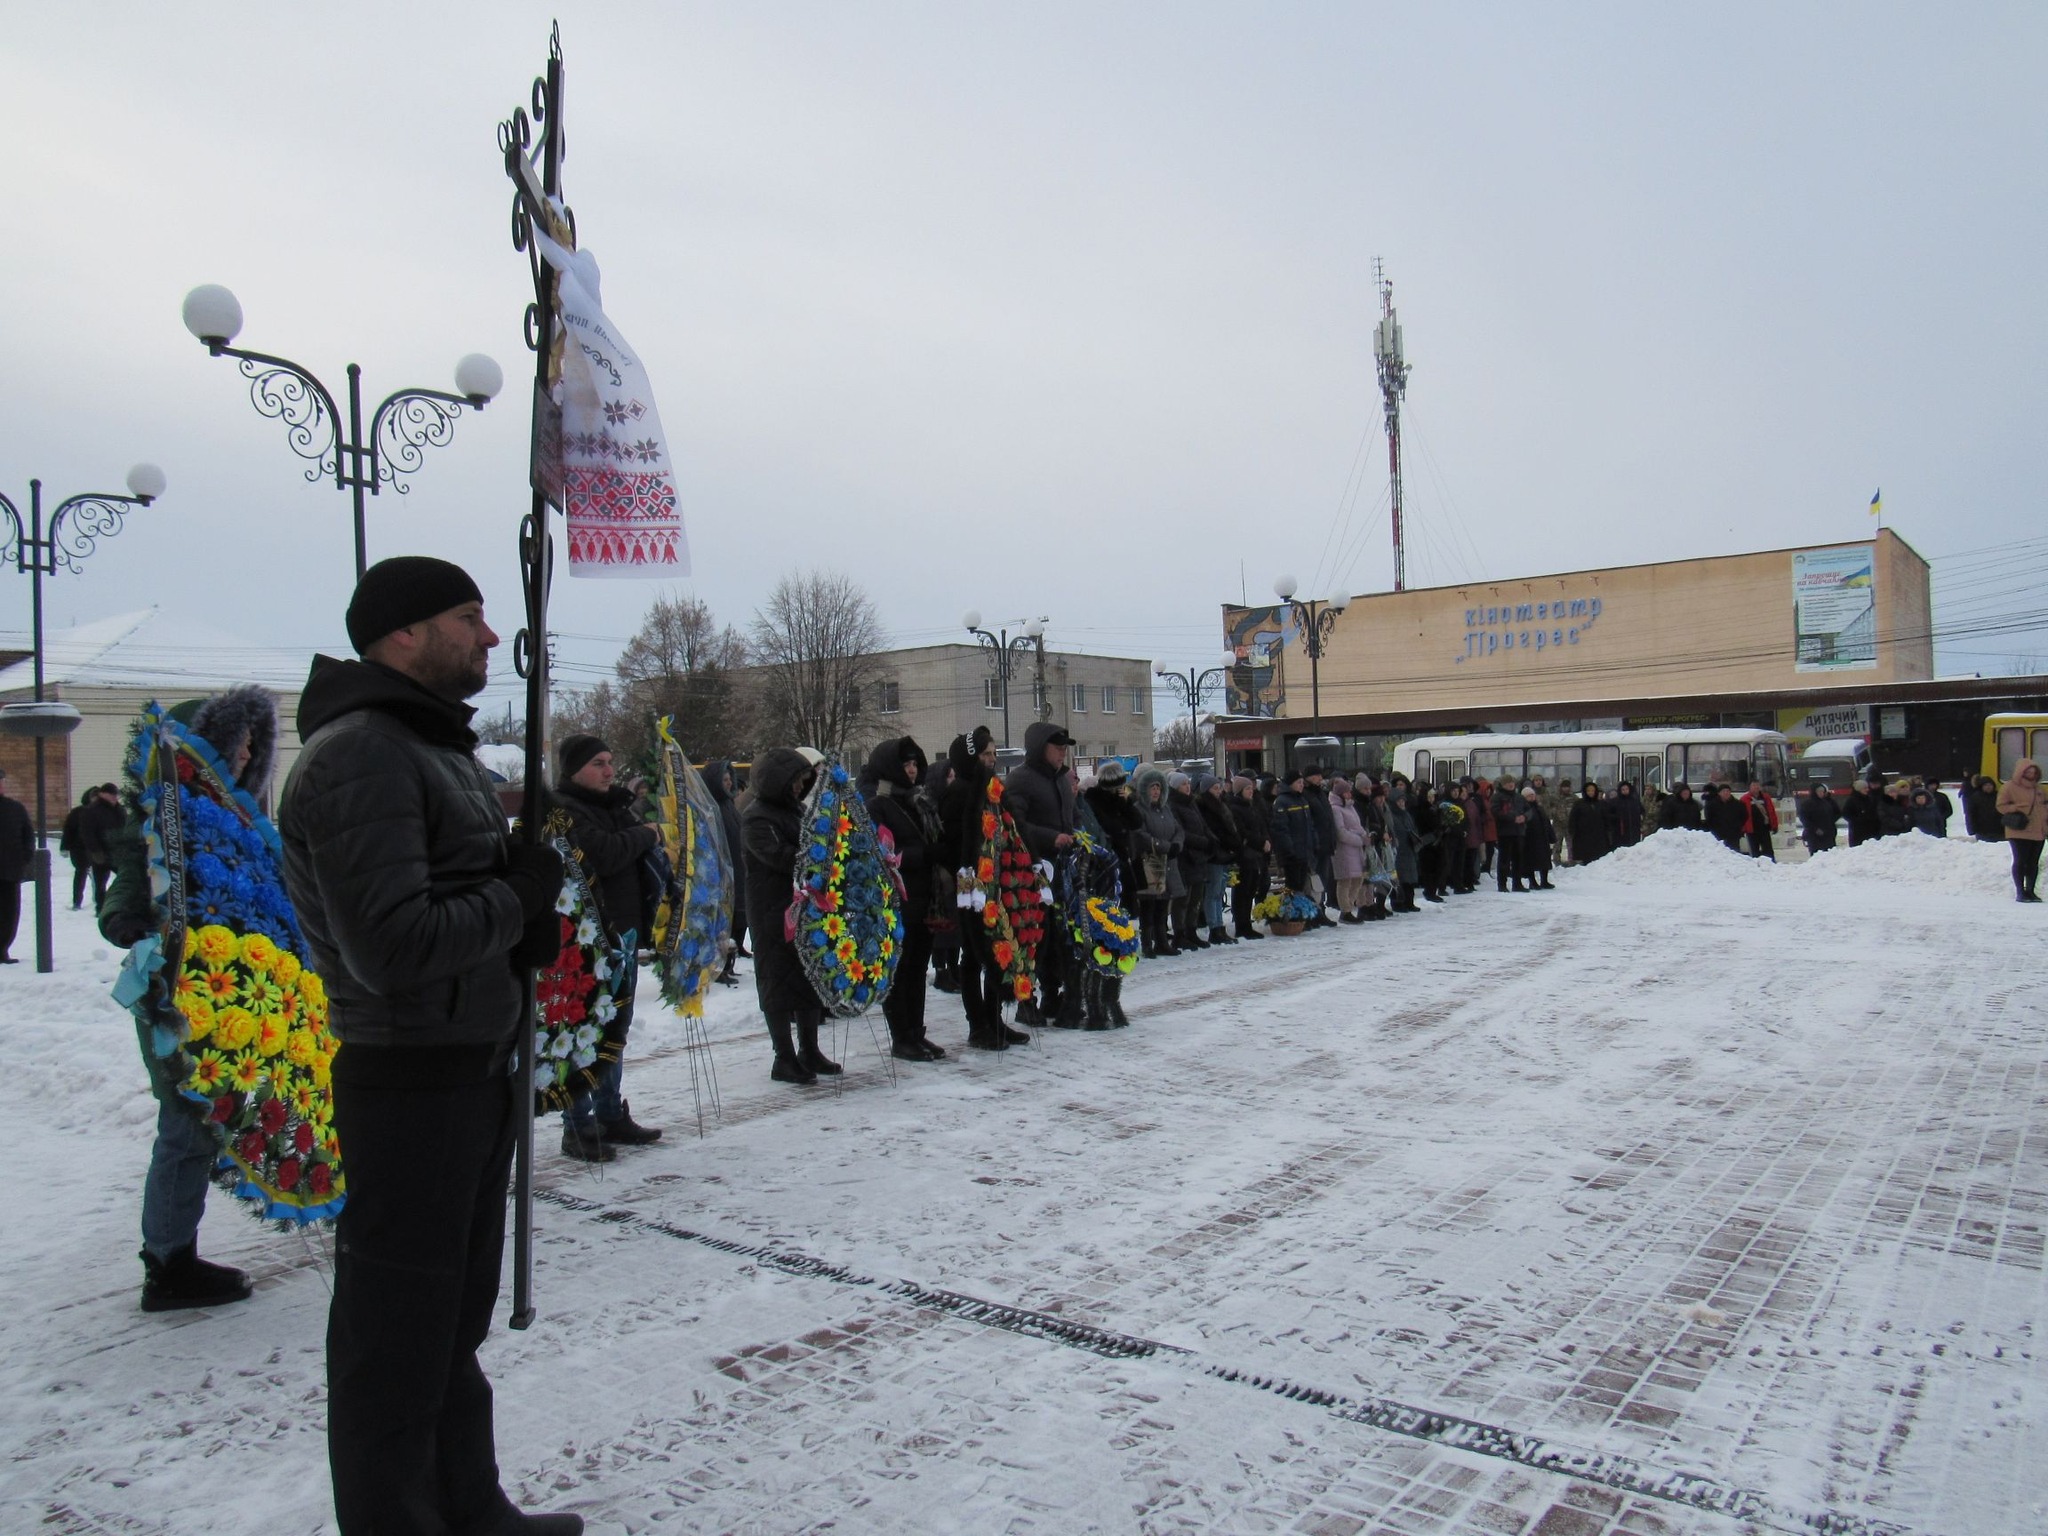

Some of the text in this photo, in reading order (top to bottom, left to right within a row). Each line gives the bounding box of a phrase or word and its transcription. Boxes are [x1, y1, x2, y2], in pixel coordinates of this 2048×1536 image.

[1806, 708, 1858, 728] ДИТЯЧИЙ
[1815, 721, 1867, 737] КІНОСВІТ
[164, 782, 178, 846] скорботою
